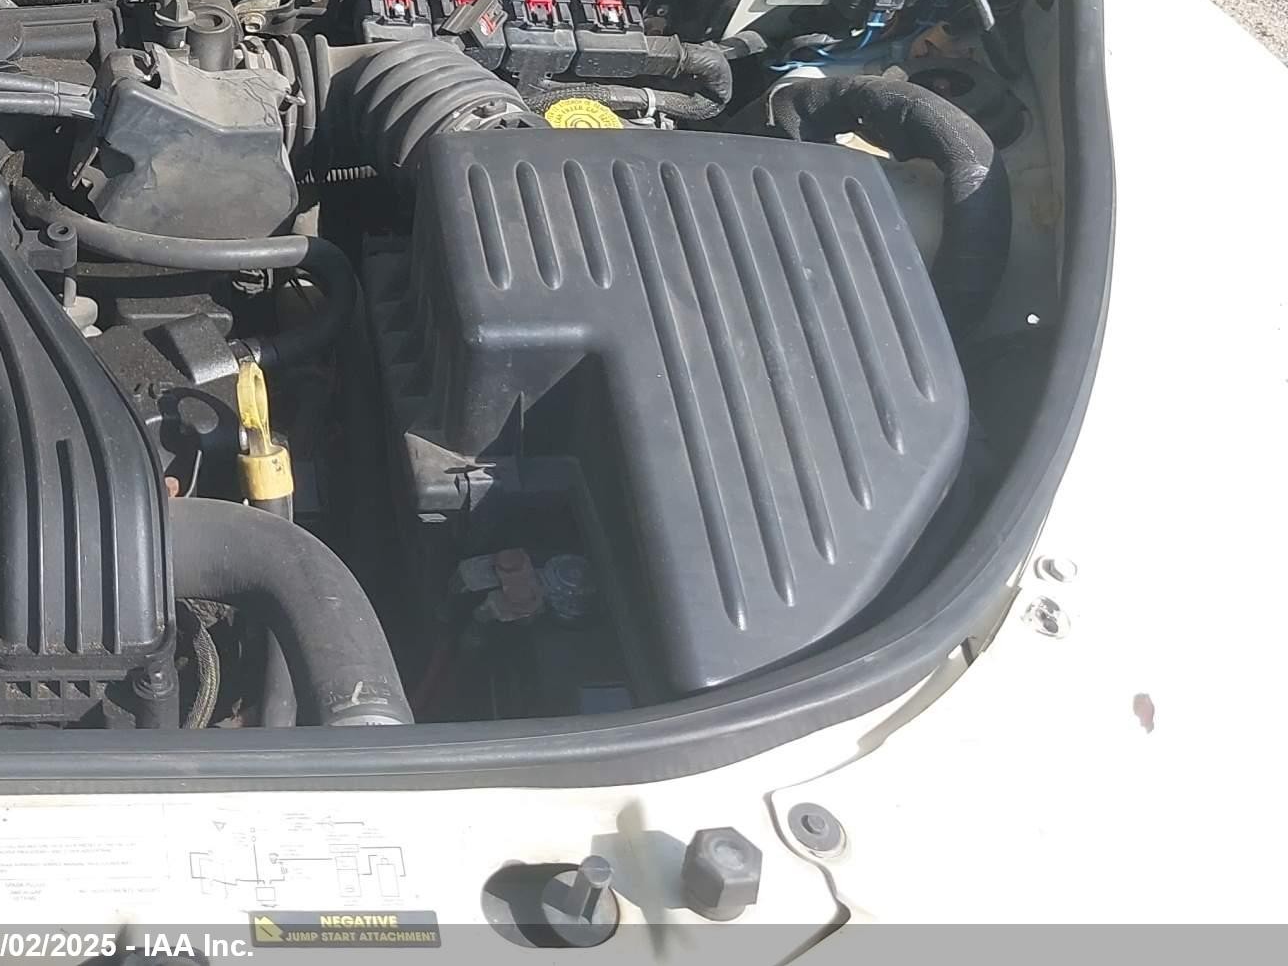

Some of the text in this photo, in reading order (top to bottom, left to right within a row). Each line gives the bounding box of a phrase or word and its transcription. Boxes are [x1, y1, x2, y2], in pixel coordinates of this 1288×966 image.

[320, 915, 398, 928] NEGATIVE
[286, 932, 436, 942] JUMP START ATTACHMENT
